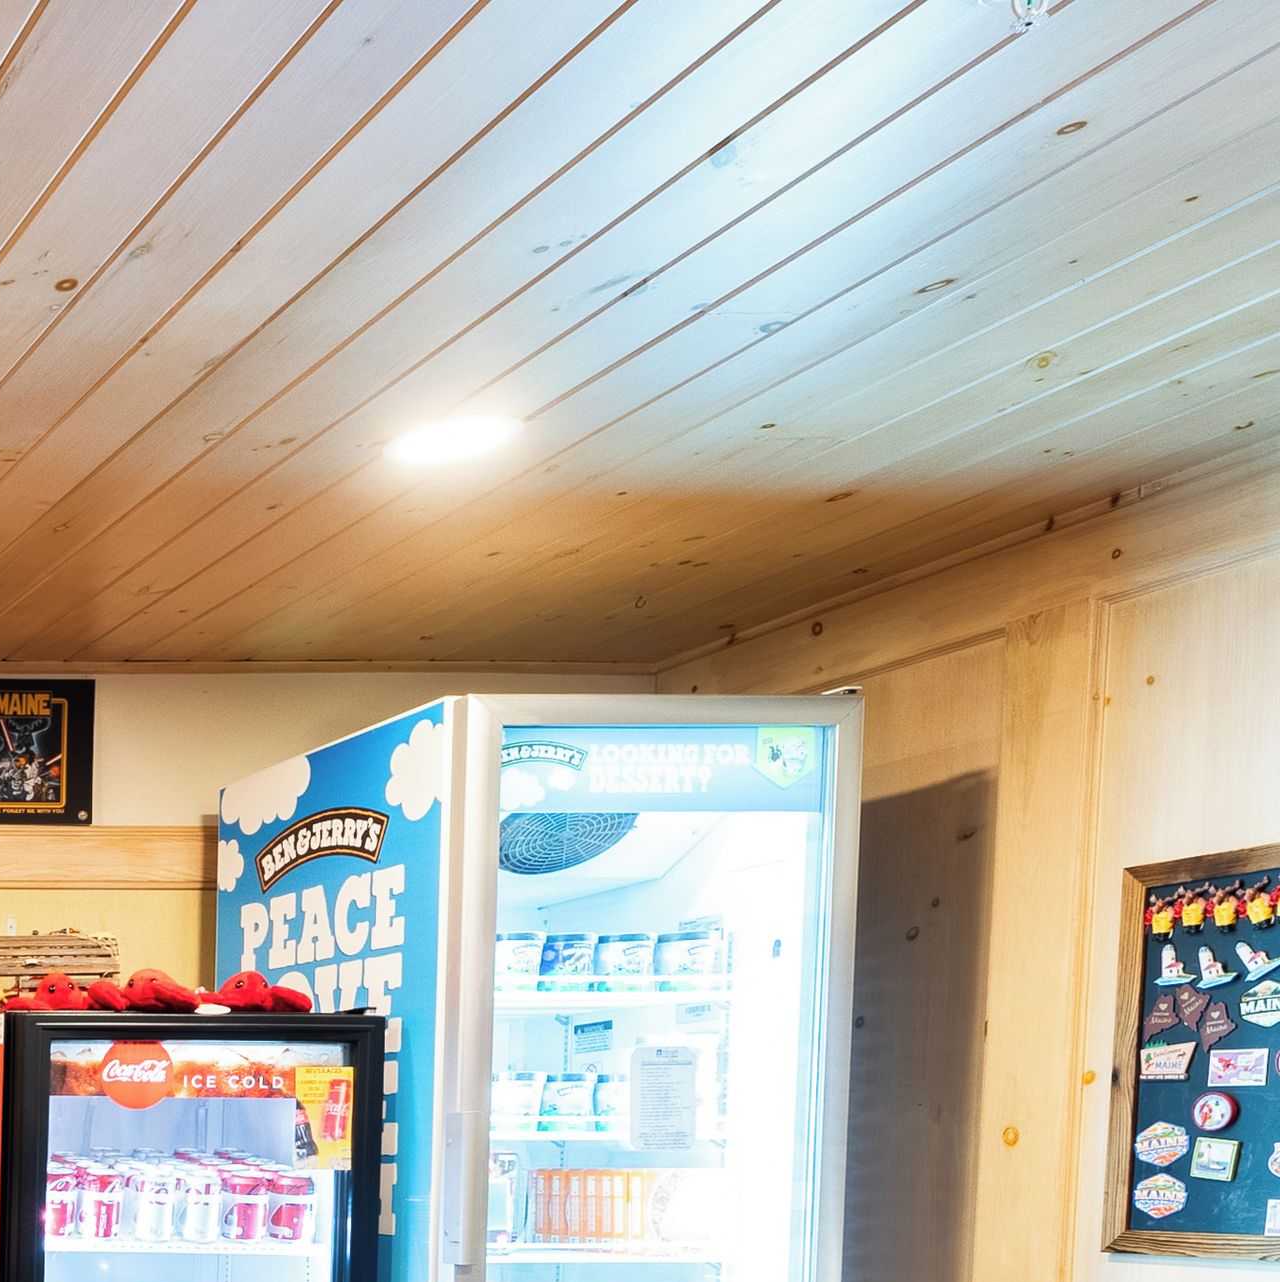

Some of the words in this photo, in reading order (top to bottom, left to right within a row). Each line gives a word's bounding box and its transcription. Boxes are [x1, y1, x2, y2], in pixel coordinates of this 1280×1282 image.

[589, 743, 697, 764] LOOKING
[700, 744, 751, 765] FOR
[589, 767, 712, 794] DESSERT?
[261, 833, 297, 882] BEN
[311, 817, 382, 853] JERRY'S
[241, 864, 406, 974] PEACE
[1240, 999, 1280, 1014] MAIN
[102, 1058, 171, 1084] Coca-Cola
[1155, 1061, 1184, 1069] MAINE
[183, 1074, 216, 1089] ICE
[228, 1074, 285, 1090] COLD
